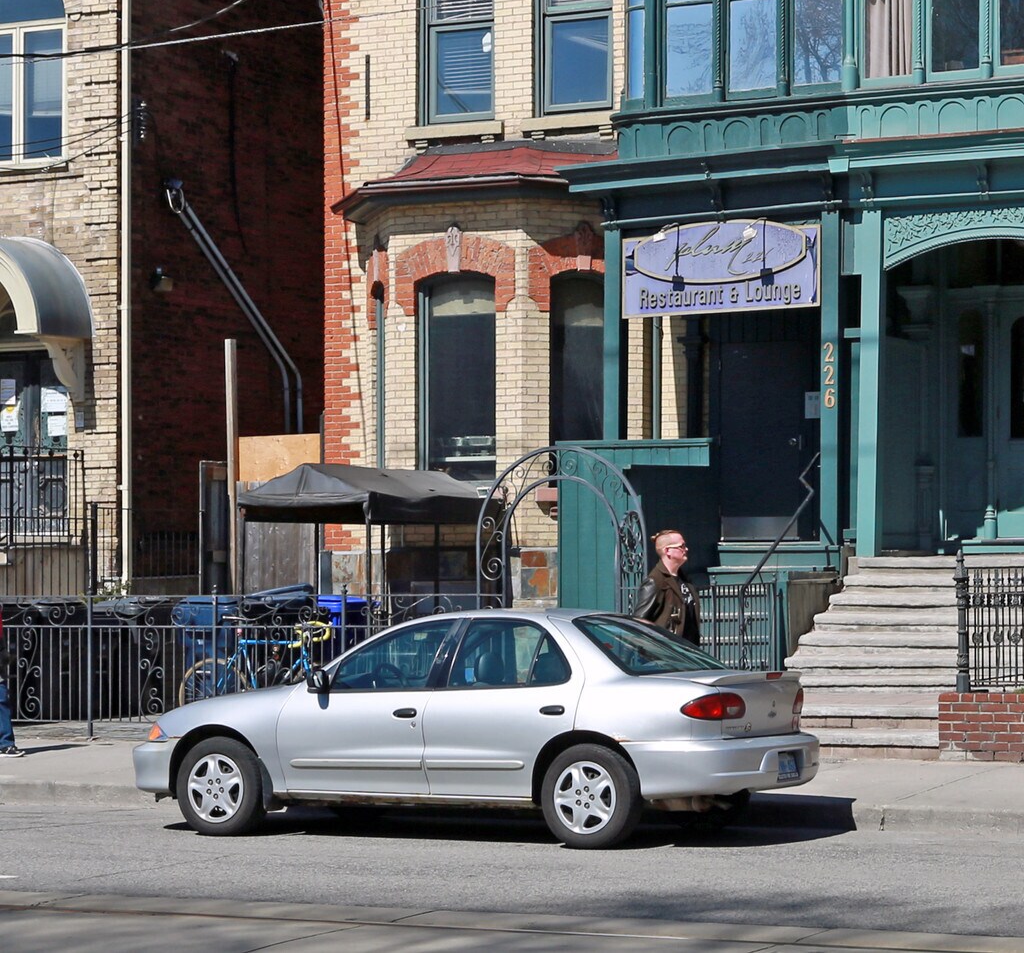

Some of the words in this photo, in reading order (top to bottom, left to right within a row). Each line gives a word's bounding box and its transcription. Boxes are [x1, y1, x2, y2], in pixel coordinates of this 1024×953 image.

[664, 226, 752, 276] plum
[639, 285, 723, 309] Restaurant
[730, 287, 739, 303] &
[745, 280, 801, 305] Lounge
[823, 342, 835, 408] 226
